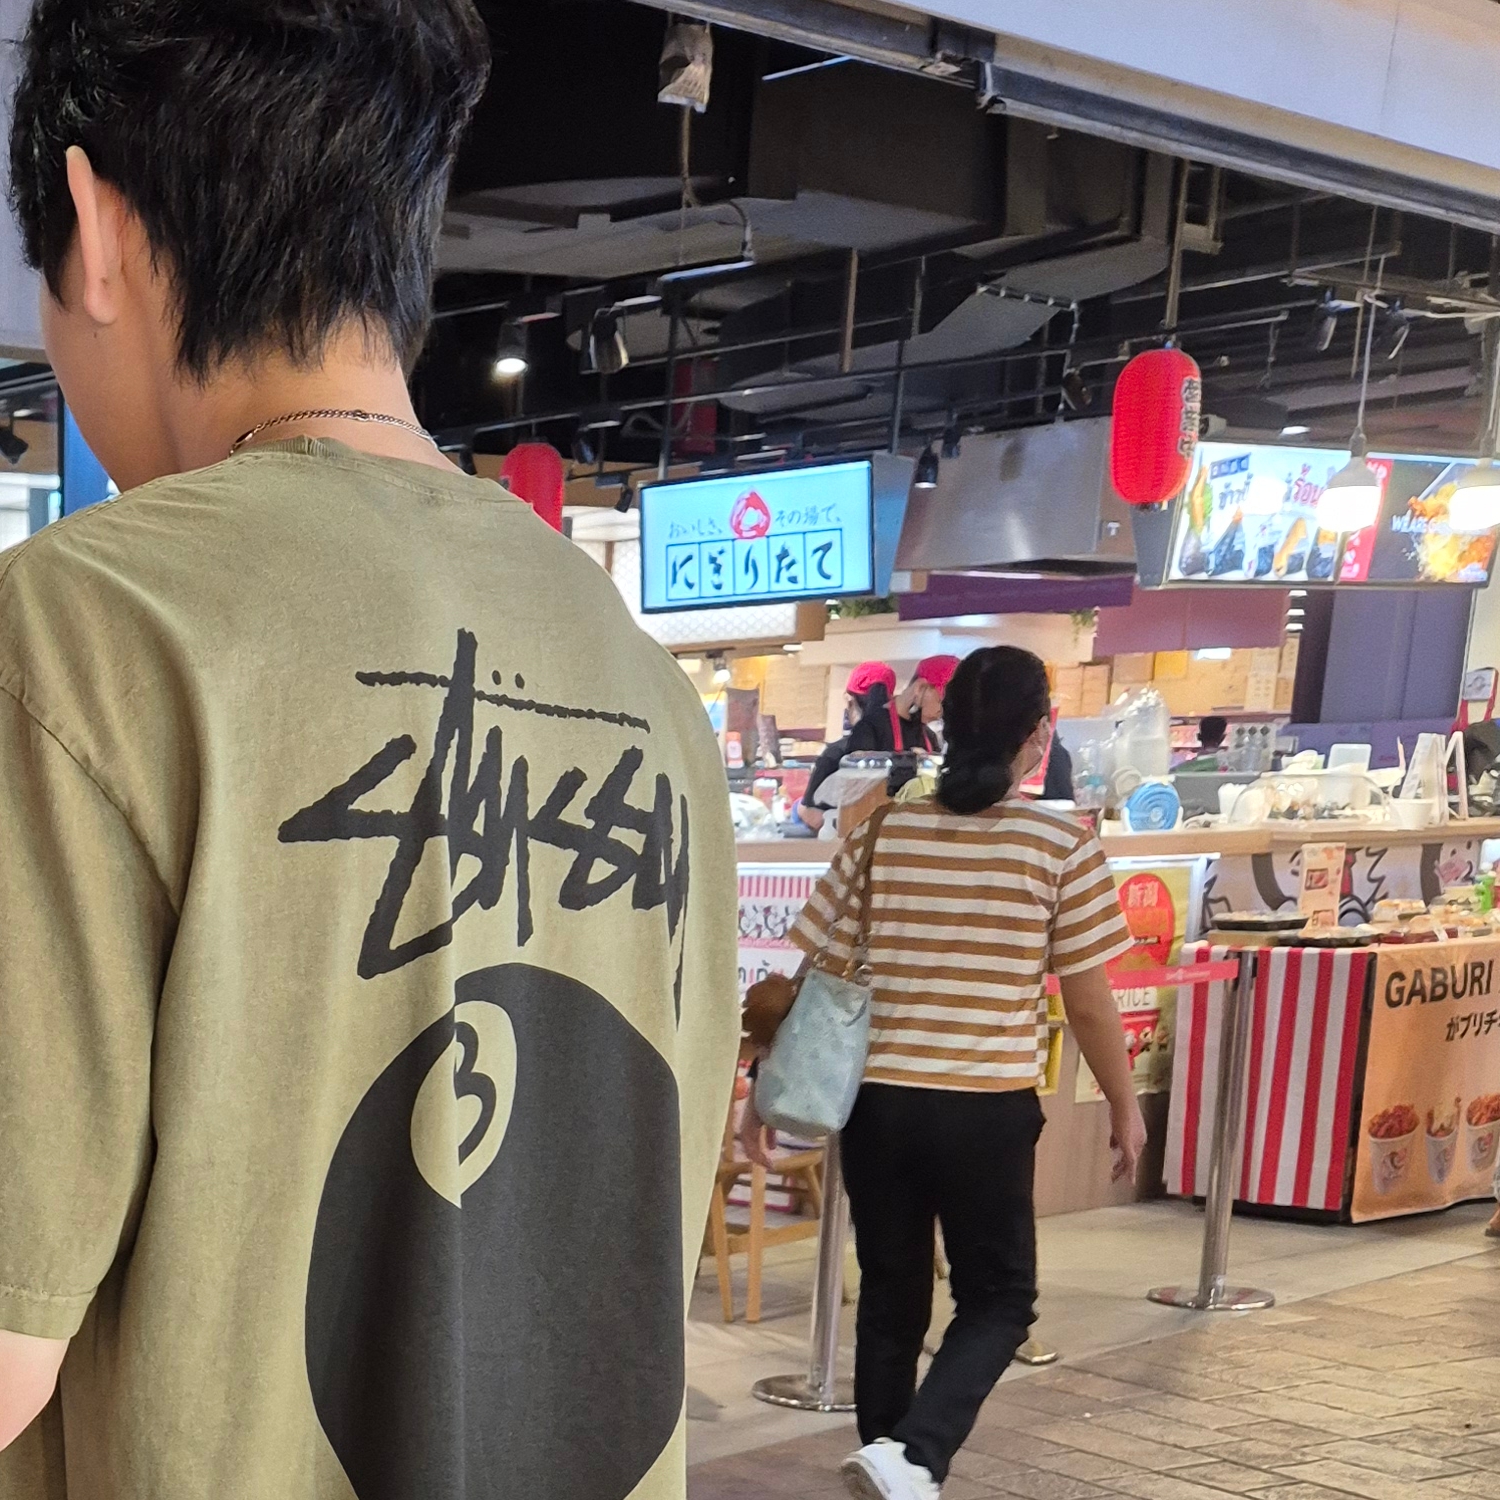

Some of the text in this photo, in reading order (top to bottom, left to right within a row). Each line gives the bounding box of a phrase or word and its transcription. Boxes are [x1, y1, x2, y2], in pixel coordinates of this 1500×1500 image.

[671, 540, 834, 591] にぎりたて
[1384, 959, 1494, 1009] GABURI
